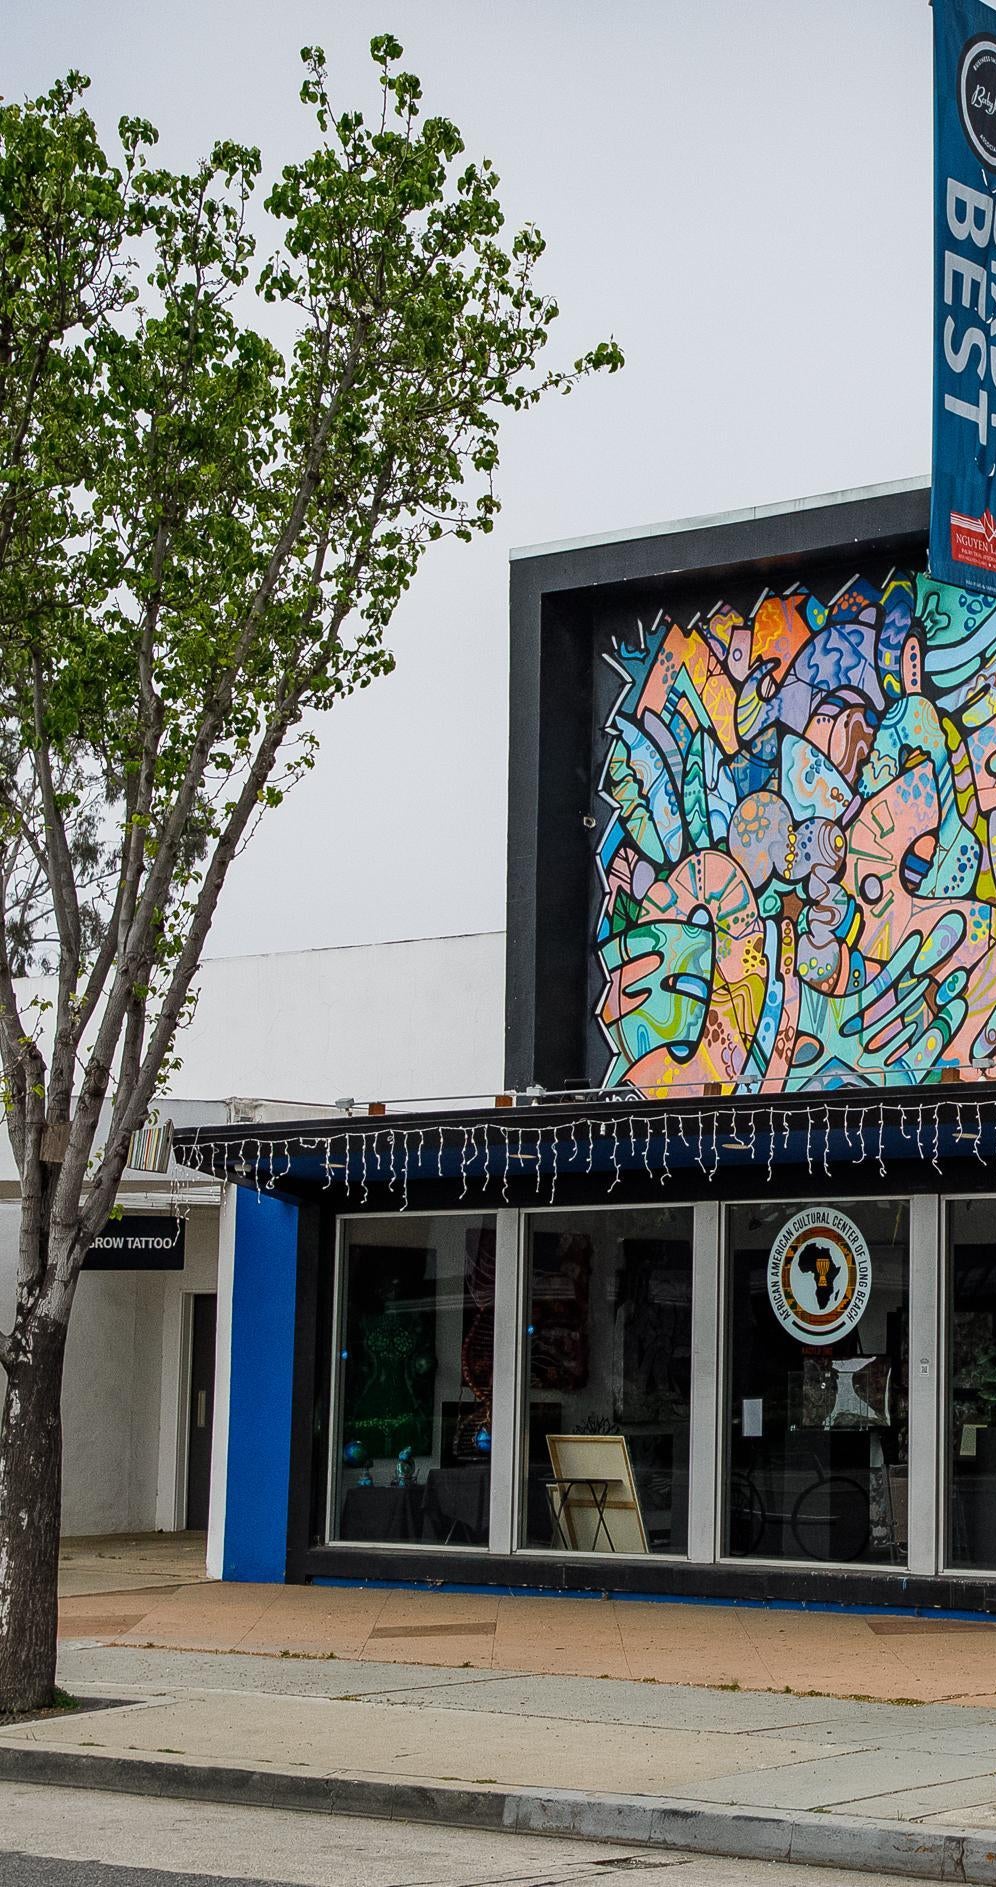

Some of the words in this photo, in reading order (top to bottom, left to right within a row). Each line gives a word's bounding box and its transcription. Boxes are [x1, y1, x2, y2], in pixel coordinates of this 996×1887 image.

[944, 177, 993, 446] BEST
[956, 533, 988, 551] NGUYEN
[793, 1211, 831, 1233] CULTURAL
[832, 1215, 860, 1245] CENTER
[126, 1237, 172, 1249] TATTOO
[770, 1227, 795, 1278] AMERICAN
[853, 1242, 866, 1258] OF
[858, 1259, 869, 1288] LONG
[770, 1281, 790, 1322] AFRICAN
[847, 1289, 867, 1324] BEACH
